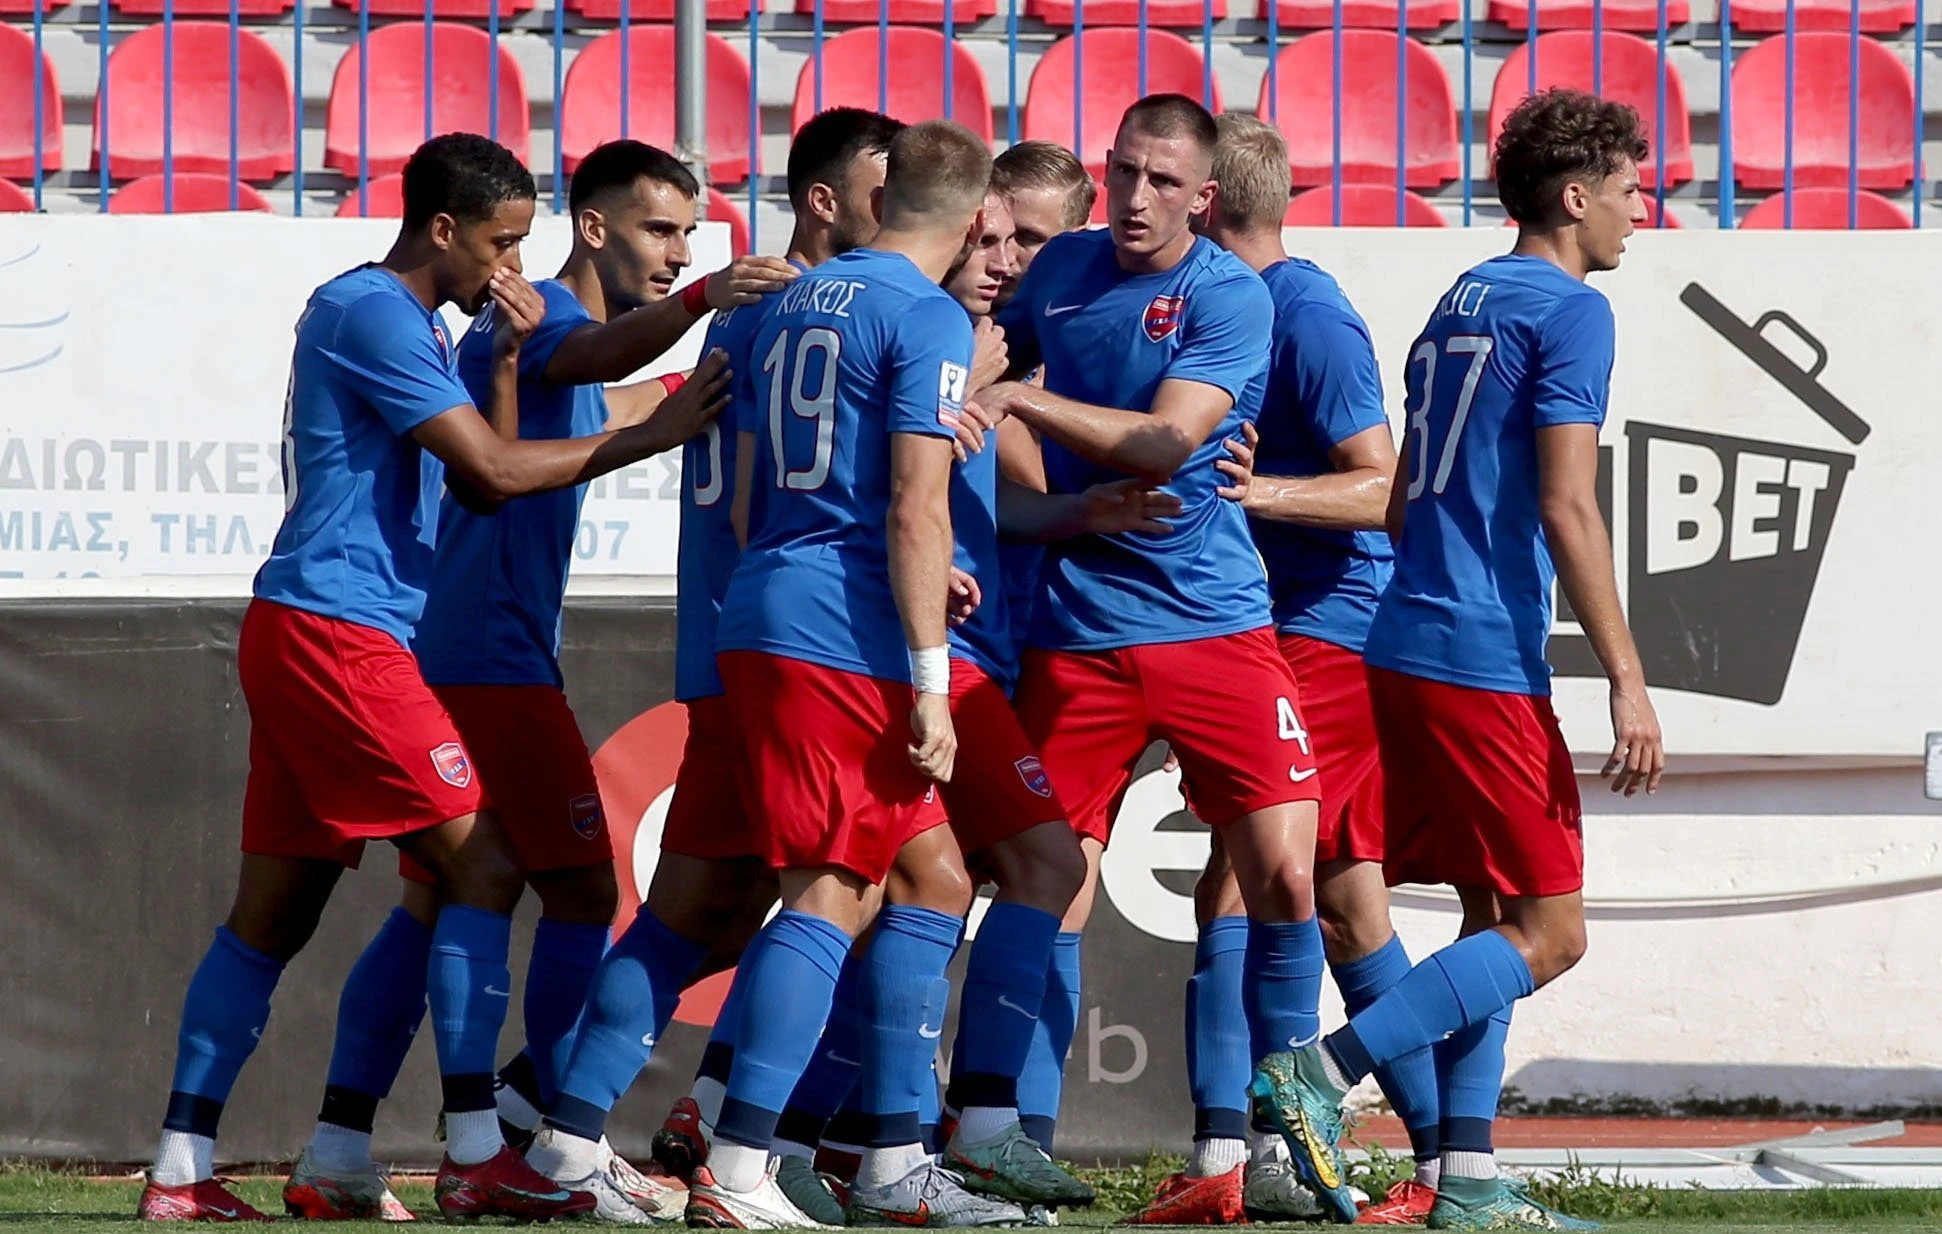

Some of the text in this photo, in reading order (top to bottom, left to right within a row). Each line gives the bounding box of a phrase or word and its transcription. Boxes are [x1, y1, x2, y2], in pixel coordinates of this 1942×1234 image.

[763, 328, 840, 490] 19
[1407, 336, 1494, 500] 37
[151, 512, 269, 555] ΤΗΛ.
[1646, 437, 1831, 575] BET
[1276, 696, 1310, 756] 4
